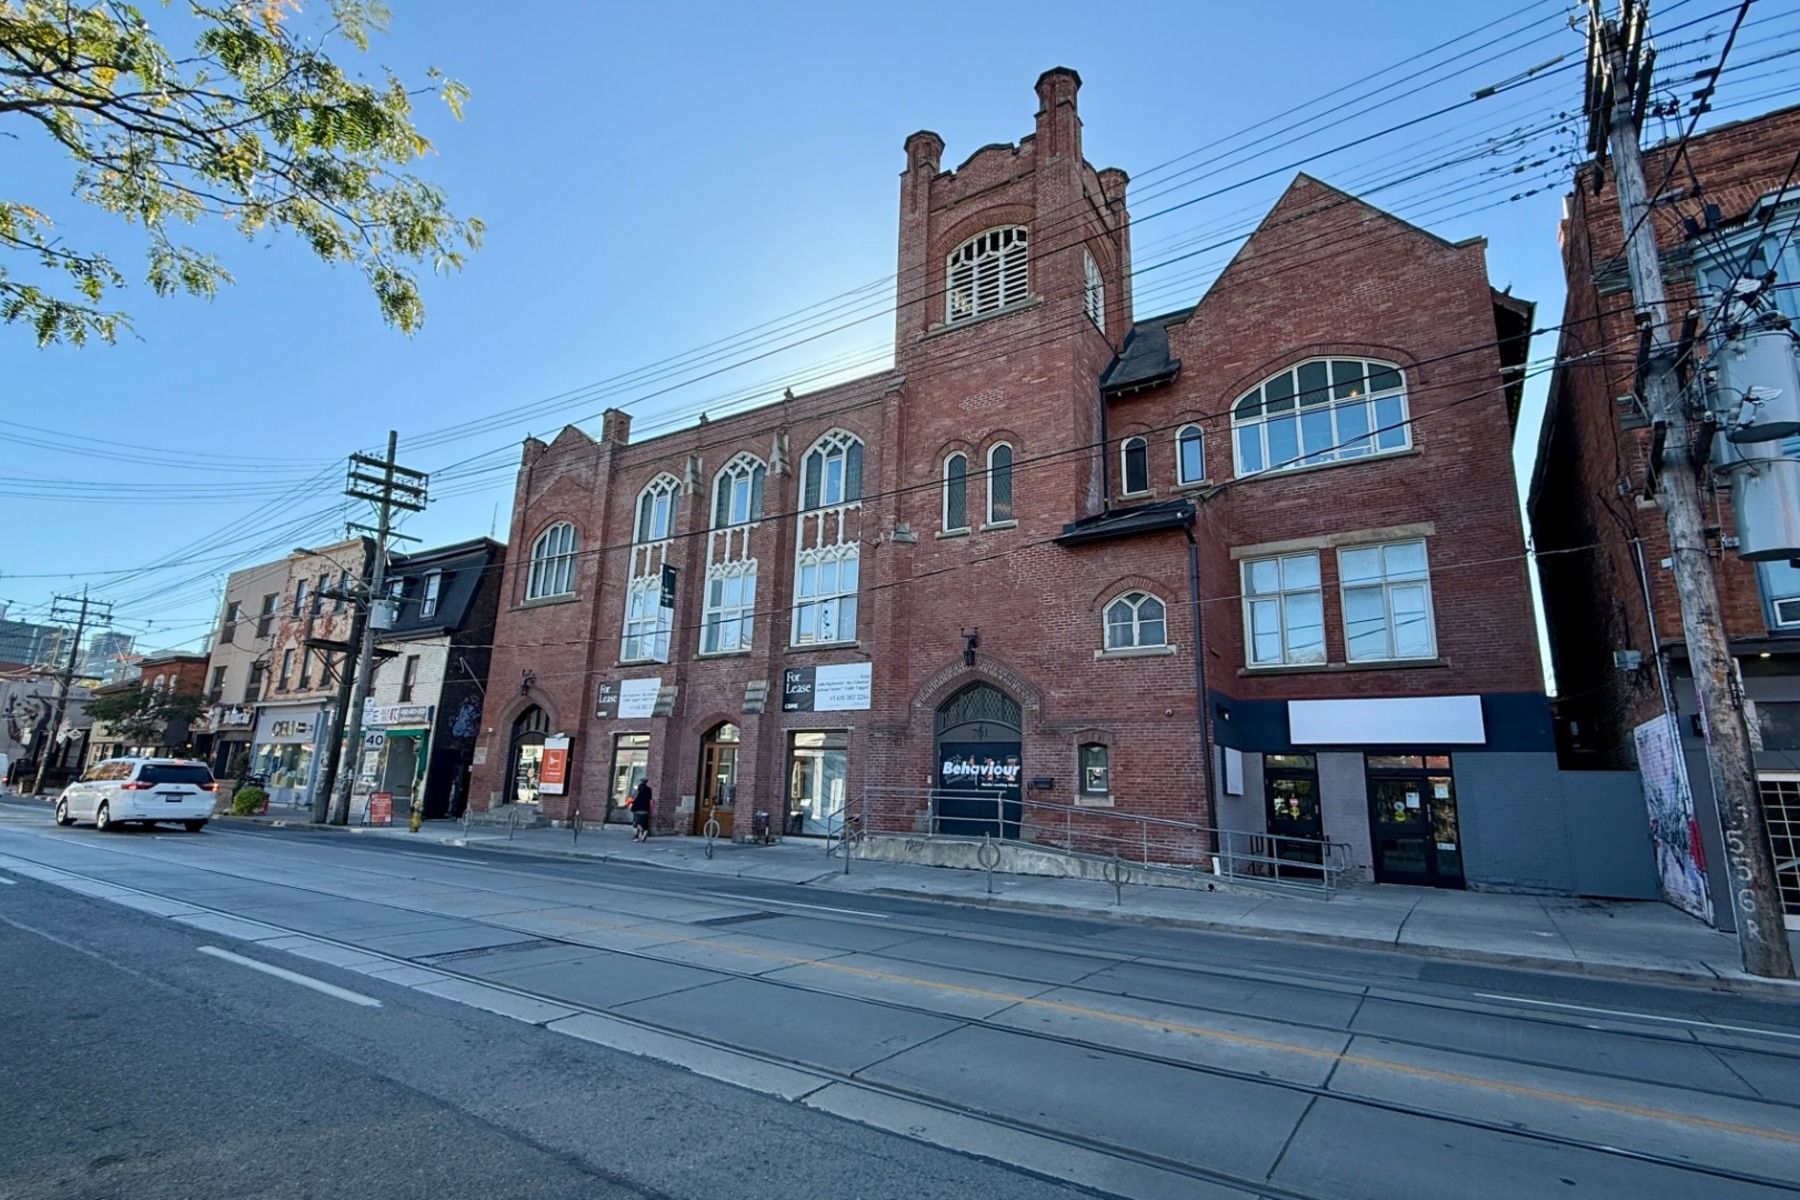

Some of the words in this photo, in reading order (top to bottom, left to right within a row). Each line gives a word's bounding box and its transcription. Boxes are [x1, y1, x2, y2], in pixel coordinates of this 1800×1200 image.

[786, 671, 801, 682] For
[600, 684, 611, 694] For
[785, 683, 811, 694] Lease
[598, 694, 618, 704] Lease
[971, 725, 988, 739] 761
[366, 735, 384, 746] 40
[942, 760, 1021, 776] Behaviour
